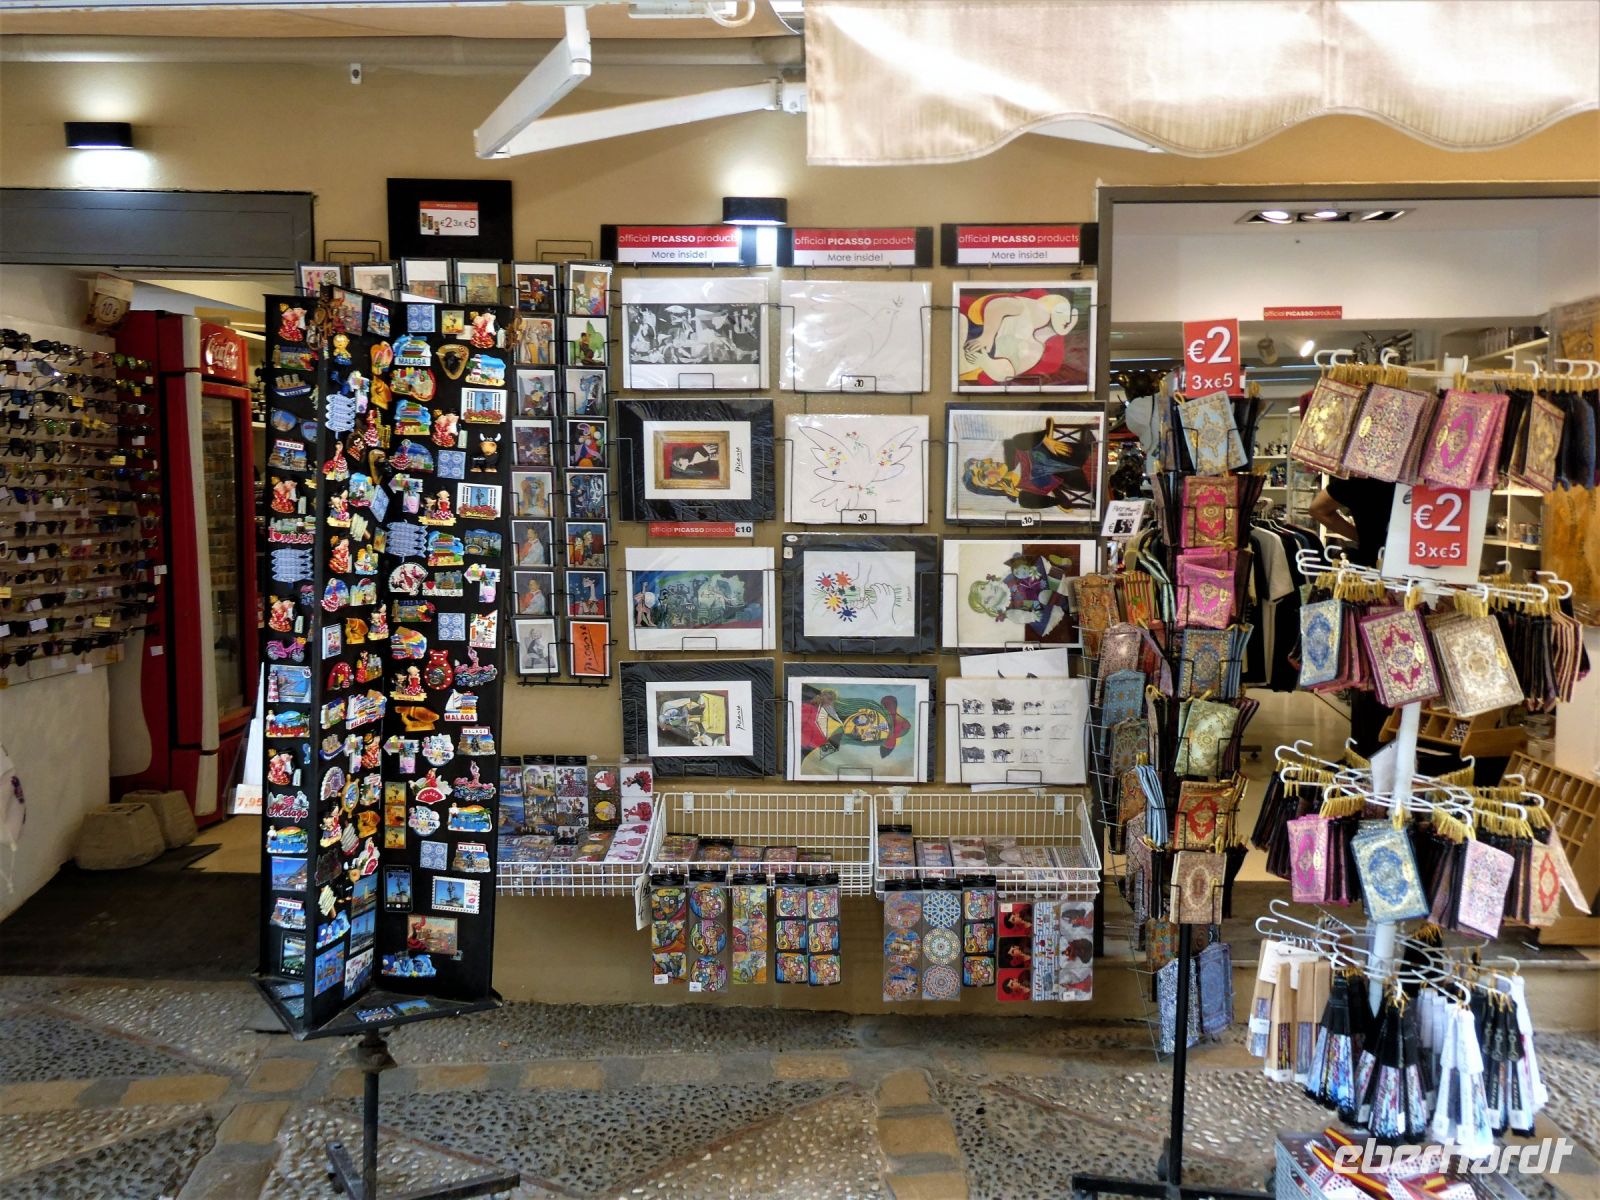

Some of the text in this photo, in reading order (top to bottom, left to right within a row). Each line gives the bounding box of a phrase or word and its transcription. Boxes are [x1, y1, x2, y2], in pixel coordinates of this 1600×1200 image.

[619, 234, 651, 243] official
[651, 235, 695, 243] PICASSO
[794, 236, 826, 245] official
[827, 237, 872, 246] PICASSO
[958, 232, 1079, 244] official PICASSO products
[651, 250, 708, 259] More inside!
[827, 252, 884, 262] More inside!
[991, 250, 1048, 260] More inside!
[1187, 326, 1232, 364] €2
[398, 357, 427, 365] MALAGA
[1413, 492, 1463, 532] €2
[735, 525, 752, 533] €10
[444, 713, 476, 721] MALAGA
